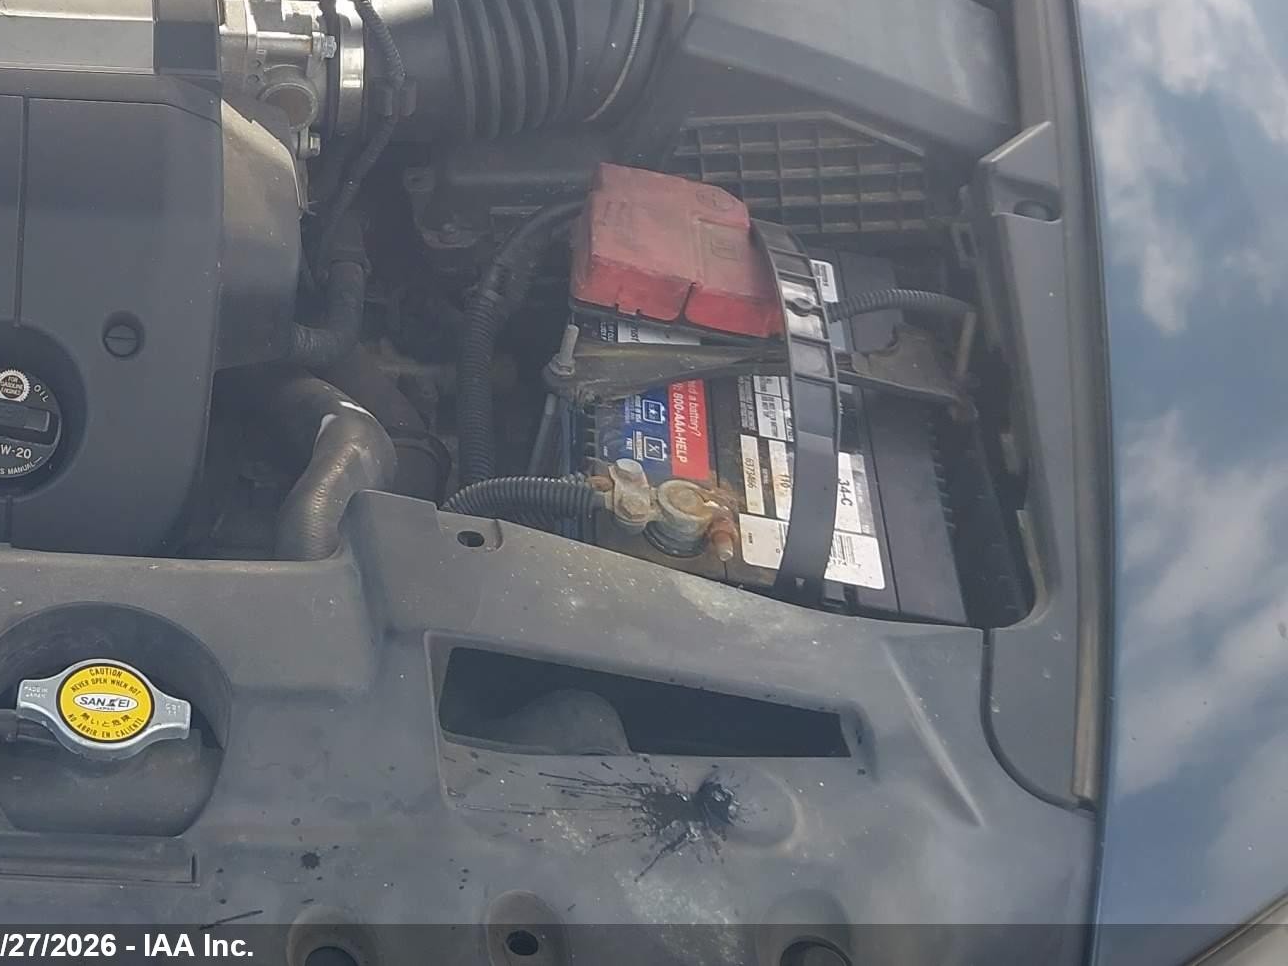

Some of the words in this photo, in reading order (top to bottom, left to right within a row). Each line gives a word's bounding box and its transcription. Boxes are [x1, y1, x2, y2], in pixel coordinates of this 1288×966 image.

[33, 384, 50, 403] OIL
[672, 392, 687, 463] 800-AAA-HELP
[686, 401, 701, 437] battery?
[7, 462, 36, 475] MANUAL
[839, 480, 853, 507] 34-C
[89, 668, 123, 679] CAUTION
[71, 679, 89, 692] NEVER
[111, 679, 129, 690] WHEN
[128, 685, 142, 696] HOT
[78, 721, 97, 737] ABRIR
